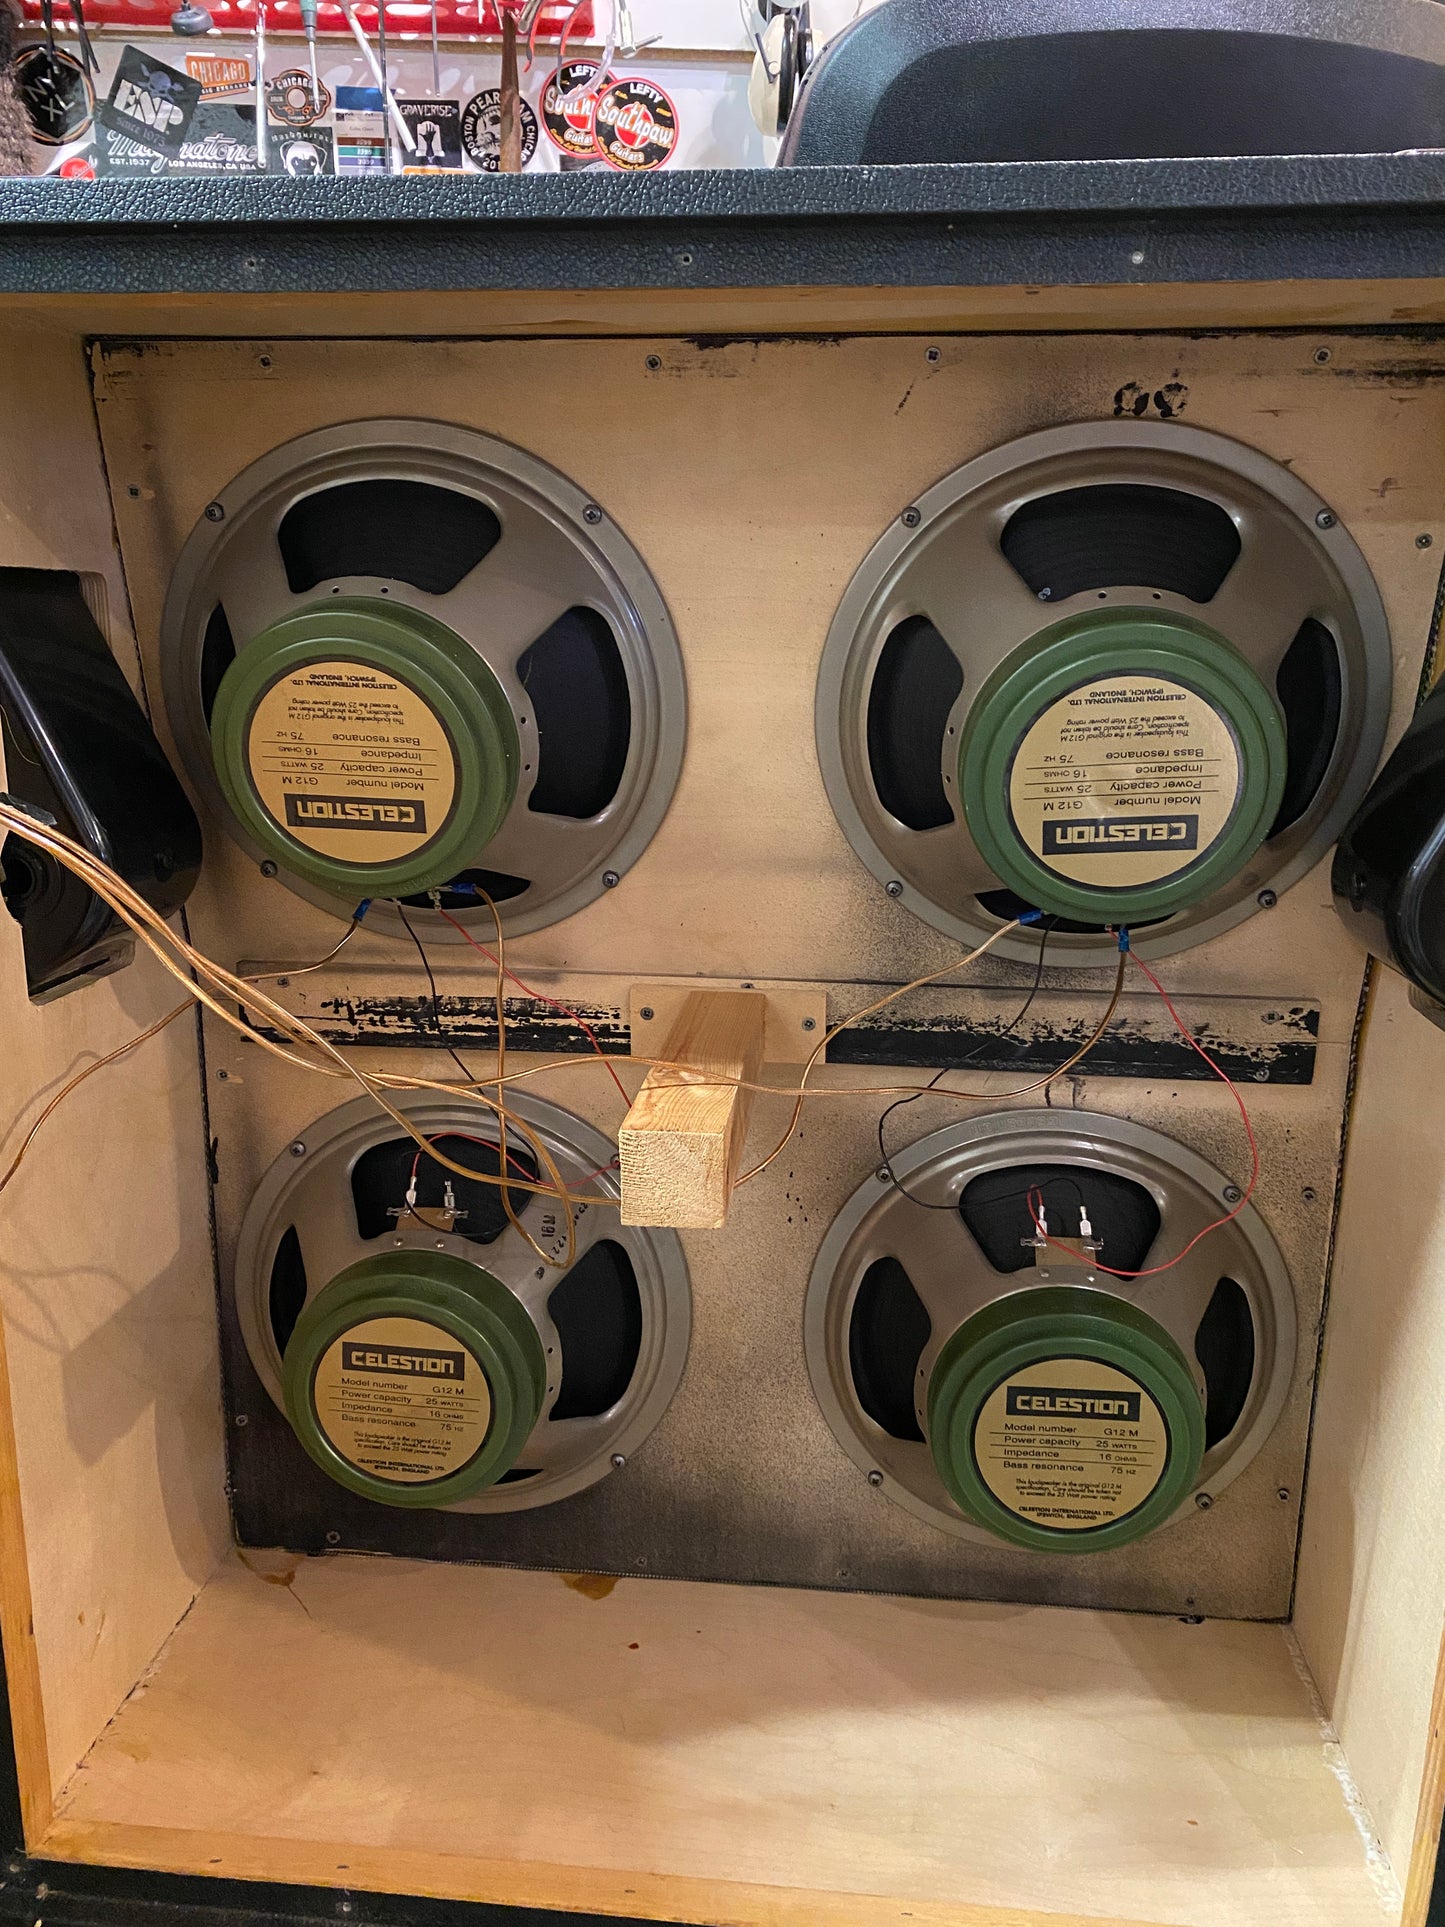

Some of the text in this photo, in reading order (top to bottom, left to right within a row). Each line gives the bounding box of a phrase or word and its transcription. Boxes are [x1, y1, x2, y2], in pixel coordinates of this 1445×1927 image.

[190, 61, 247, 84] CHICAGO
[629, 82, 664, 104] LEFTY
[597, 94, 675, 149] Southpaw
[463, 115, 479, 157] BOSTON
[610, 142, 644, 163] Guitars
[306, 680, 359, 688] INTERNATIONAL
[1129, 688, 1163, 696] IPSWICH,
[1085, 696, 1144, 704] INTERNATIONAL
[1147, 694, 1186, 702] CELESTION
[291, 732, 304, 740] 75
[332, 734, 389, 743] resonance
[393, 737, 420, 746] Bass
[361, 750, 421, 761] Impedance
[1060, 755, 1074, 763] 75
[1106, 750, 1169, 759] resonance
[1174, 749, 1204, 758] Bass
[311, 762, 324, 770] 25
[340, 763, 384, 773] capacity
[389, 767, 422, 776] Power
[1136, 764, 1202, 773] Impedance
[282, 776, 424, 791] Model number G12 M
[1077, 785, 1092, 793] 25
[1110, 781, 1159, 791] capacity
[1163, 780, 1202, 789] Power
[1043, 796, 1201, 810] Model number G12 M
[297, 800, 415, 822] CELESTION
[1056, 823, 1186, 844] CELESTION
[351, 1351, 454, 1373] CELESTION
[341, 1378, 369, 1387] Model
[373, 1382, 408, 1390] number
[342, 1390, 370, 1399] Power
[373, 1394, 411, 1404] capacity
[342, 1402, 392, 1413] Impedance
[1016, 1395, 1128, 1415] CELESTION
[342, 1414, 364, 1422] Bass
[368, 1418, 416, 1427] resonance
[1005, 1423, 1035, 1432] Model
[1039, 1425, 1077, 1433] number
[1104, 1428, 1125, 1436] G12
[1004, 1436, 1036, 1444] Power
[1040, 1439, 1081, 1447] capacity
[1004, 1449, 1059, 1458] Impedance
[1004, 1461, 1028, 1469] Bass
[1031, 1463, 1084, 1472] resonance
